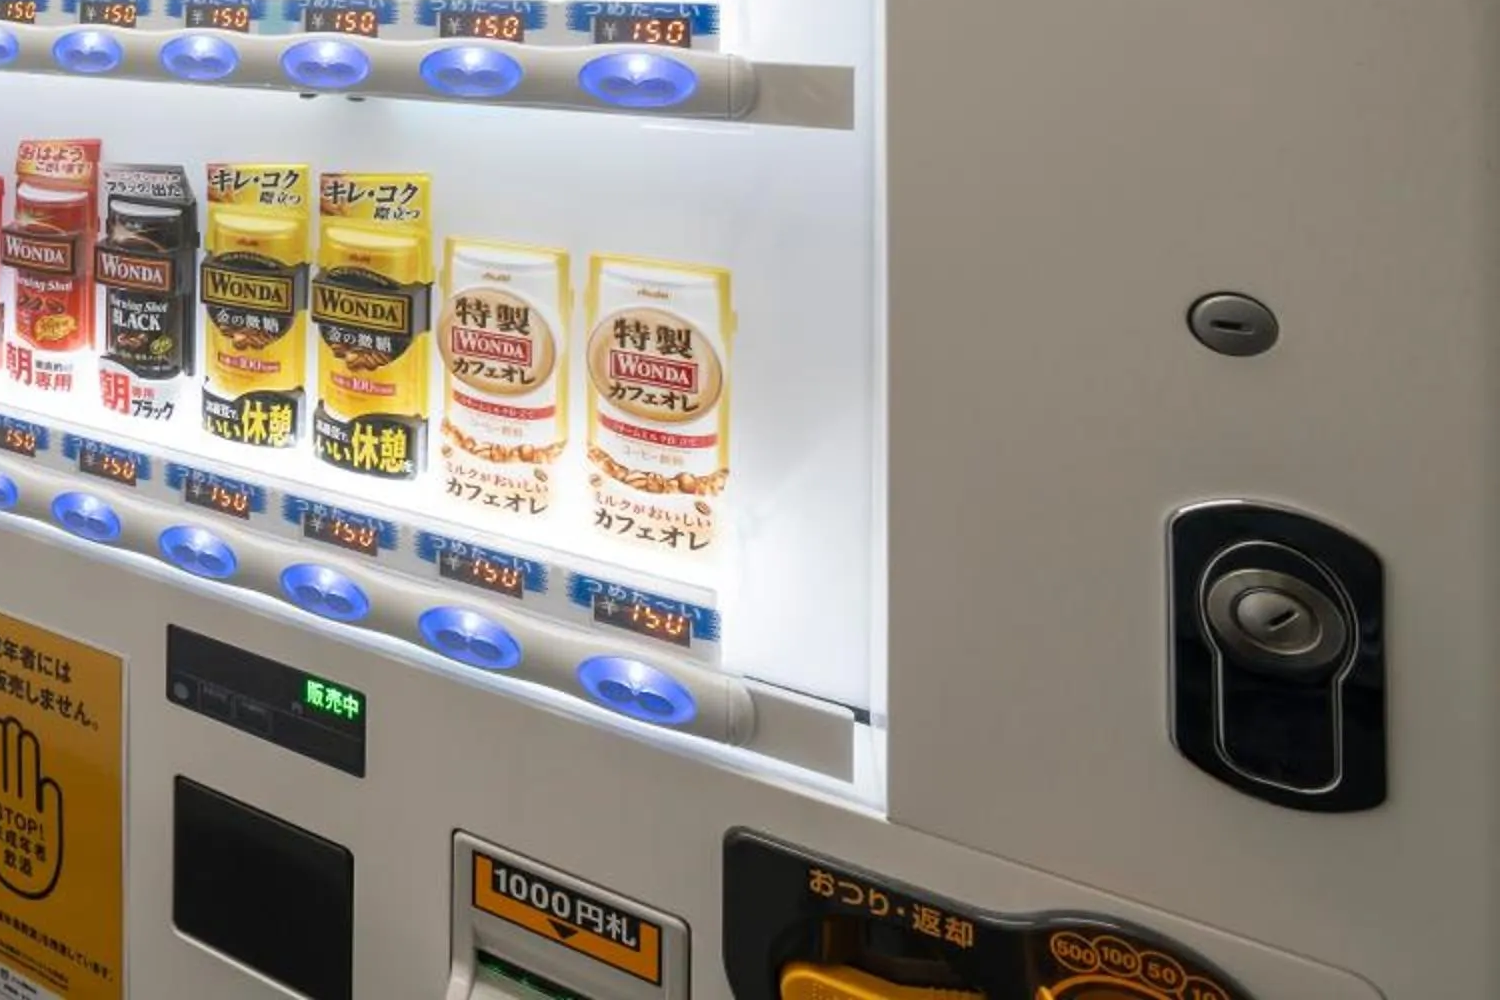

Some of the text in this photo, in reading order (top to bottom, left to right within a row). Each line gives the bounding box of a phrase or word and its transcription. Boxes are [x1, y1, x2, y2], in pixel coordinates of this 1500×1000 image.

[6, 1, 35, 19] 150
[104, 4, 135, 23] 150
[211, 7, 248, 28] 150
[334, 11, 375, 33] 150
[472, 15, 519, 38] 150
[632, 20, 686, 44] 150
[19, 144, 83, 161] おはよう
[211, 168, 300, 192] キレ・コク
[324, 180, 419, 205] キレ・コク
[5, 234, 66, 265] WONDA
[100, 252, 163, 285] WONDA
[210, 273, 282, 303] WONDA
[113, 308, 162, 331] BLACK
[319, 289, 398, 323] WONDA
[456, 297, 531, 336] 特製
[216, 309, 280, 333] 金の微糖
[459, 330, 525, 359] WONDA
[613, 317, 694, 360] 特製
[6, 341, 33, 387] 朝
[452, 357, 536, 386] カフェオレ
[617, 354, 691, 386] WONDA
[35, 371, 73, 392] 専用
[100, 369, 131, 415] 朝
[131, 399, 175, 421] ブラック
[609, 384, 699, 413] カフェオレ
[446, 460, 549, 494] ミルクがおいしい
[446, 477, 548, 516] カフェオレ
[593, 490, 712, 528] ミルクがおいしい
[594, 508, 710, 551] カフェオレ
[306, 679, 360, 720] 販売中
[492, 867, 638, 948] 1000円札
[808, 868, 975, 949] おつり・返却
[1057, 938, 1096, 966] 500
[1101, 945, 1137, 970] 100
[1147, 962, 1177, 985] 50
